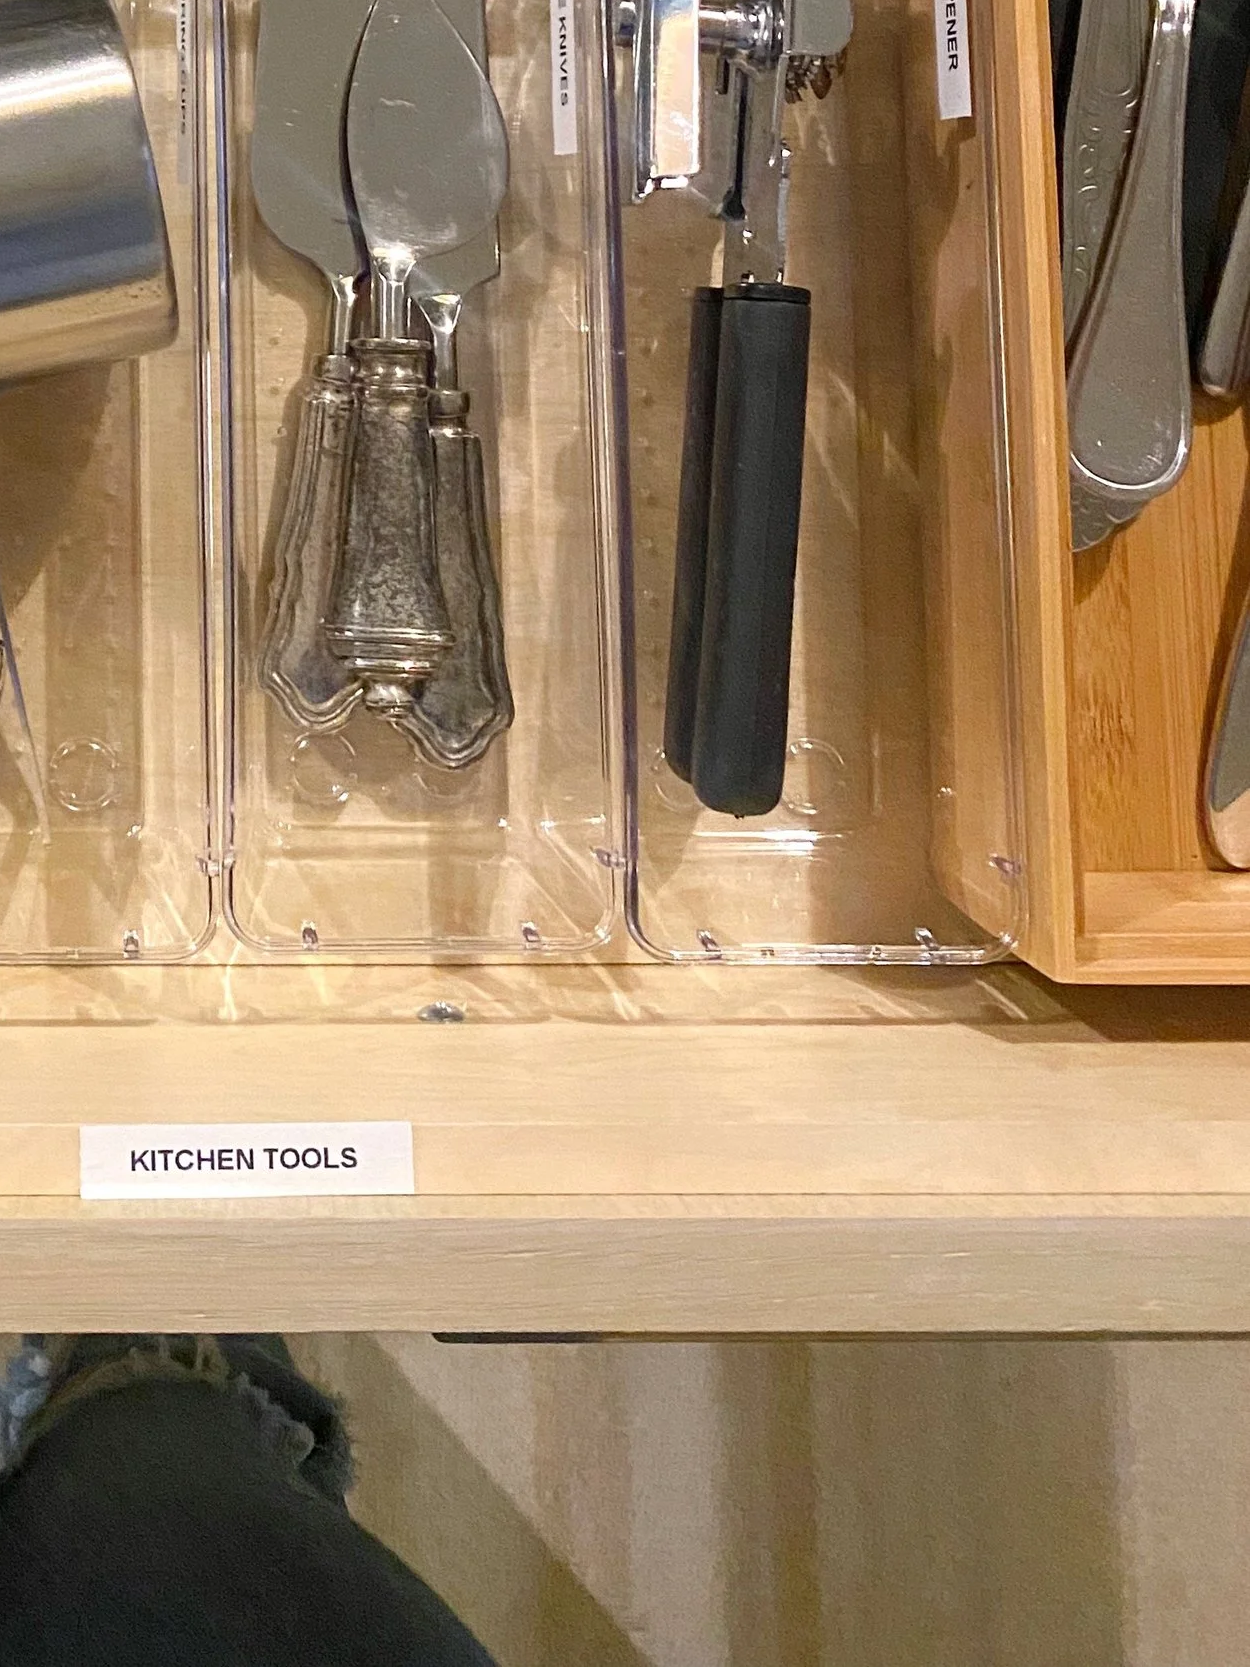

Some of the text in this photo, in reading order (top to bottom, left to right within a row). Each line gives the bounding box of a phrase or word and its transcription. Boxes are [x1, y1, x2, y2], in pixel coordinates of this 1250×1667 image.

[558, 16, 569, 107] KNIVES
[130, 1146, 358, 1172] KITCHEN TOOLS
